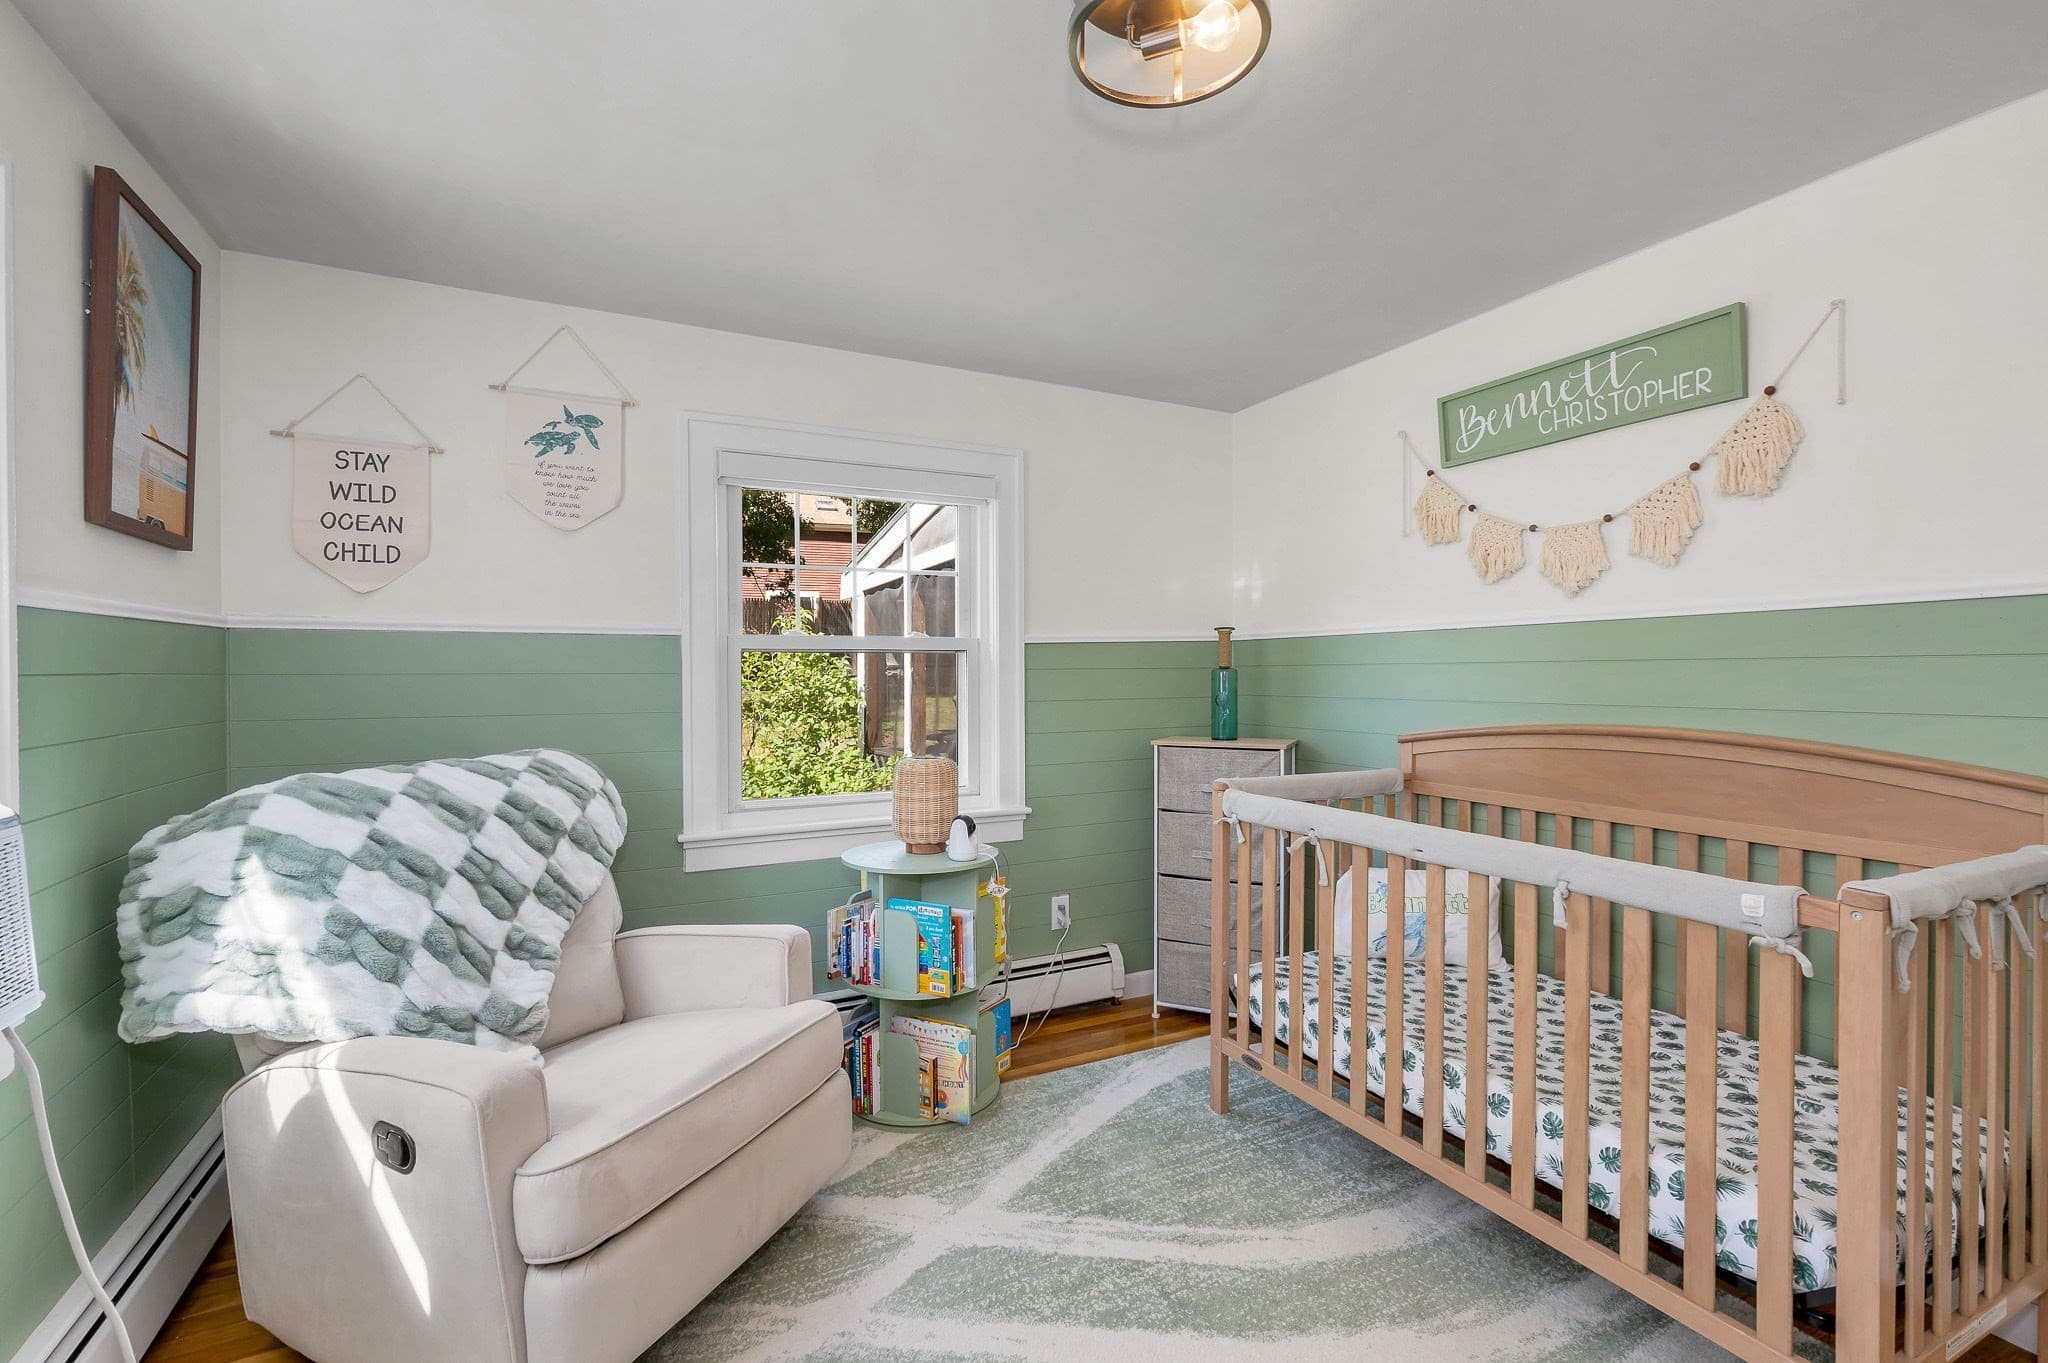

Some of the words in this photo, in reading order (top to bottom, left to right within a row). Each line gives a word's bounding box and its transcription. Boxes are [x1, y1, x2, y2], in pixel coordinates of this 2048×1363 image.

[1456, 346, 1657, 453] Bennett
[1538, 367, 1713, 434] CHRISTOPHER
[335, 450, 390, 473] STAY
[329, 481, 397, 504] WILD
[320, 511, 404, 534] OCEAN
[323, 541, 401, 564] CHILD
